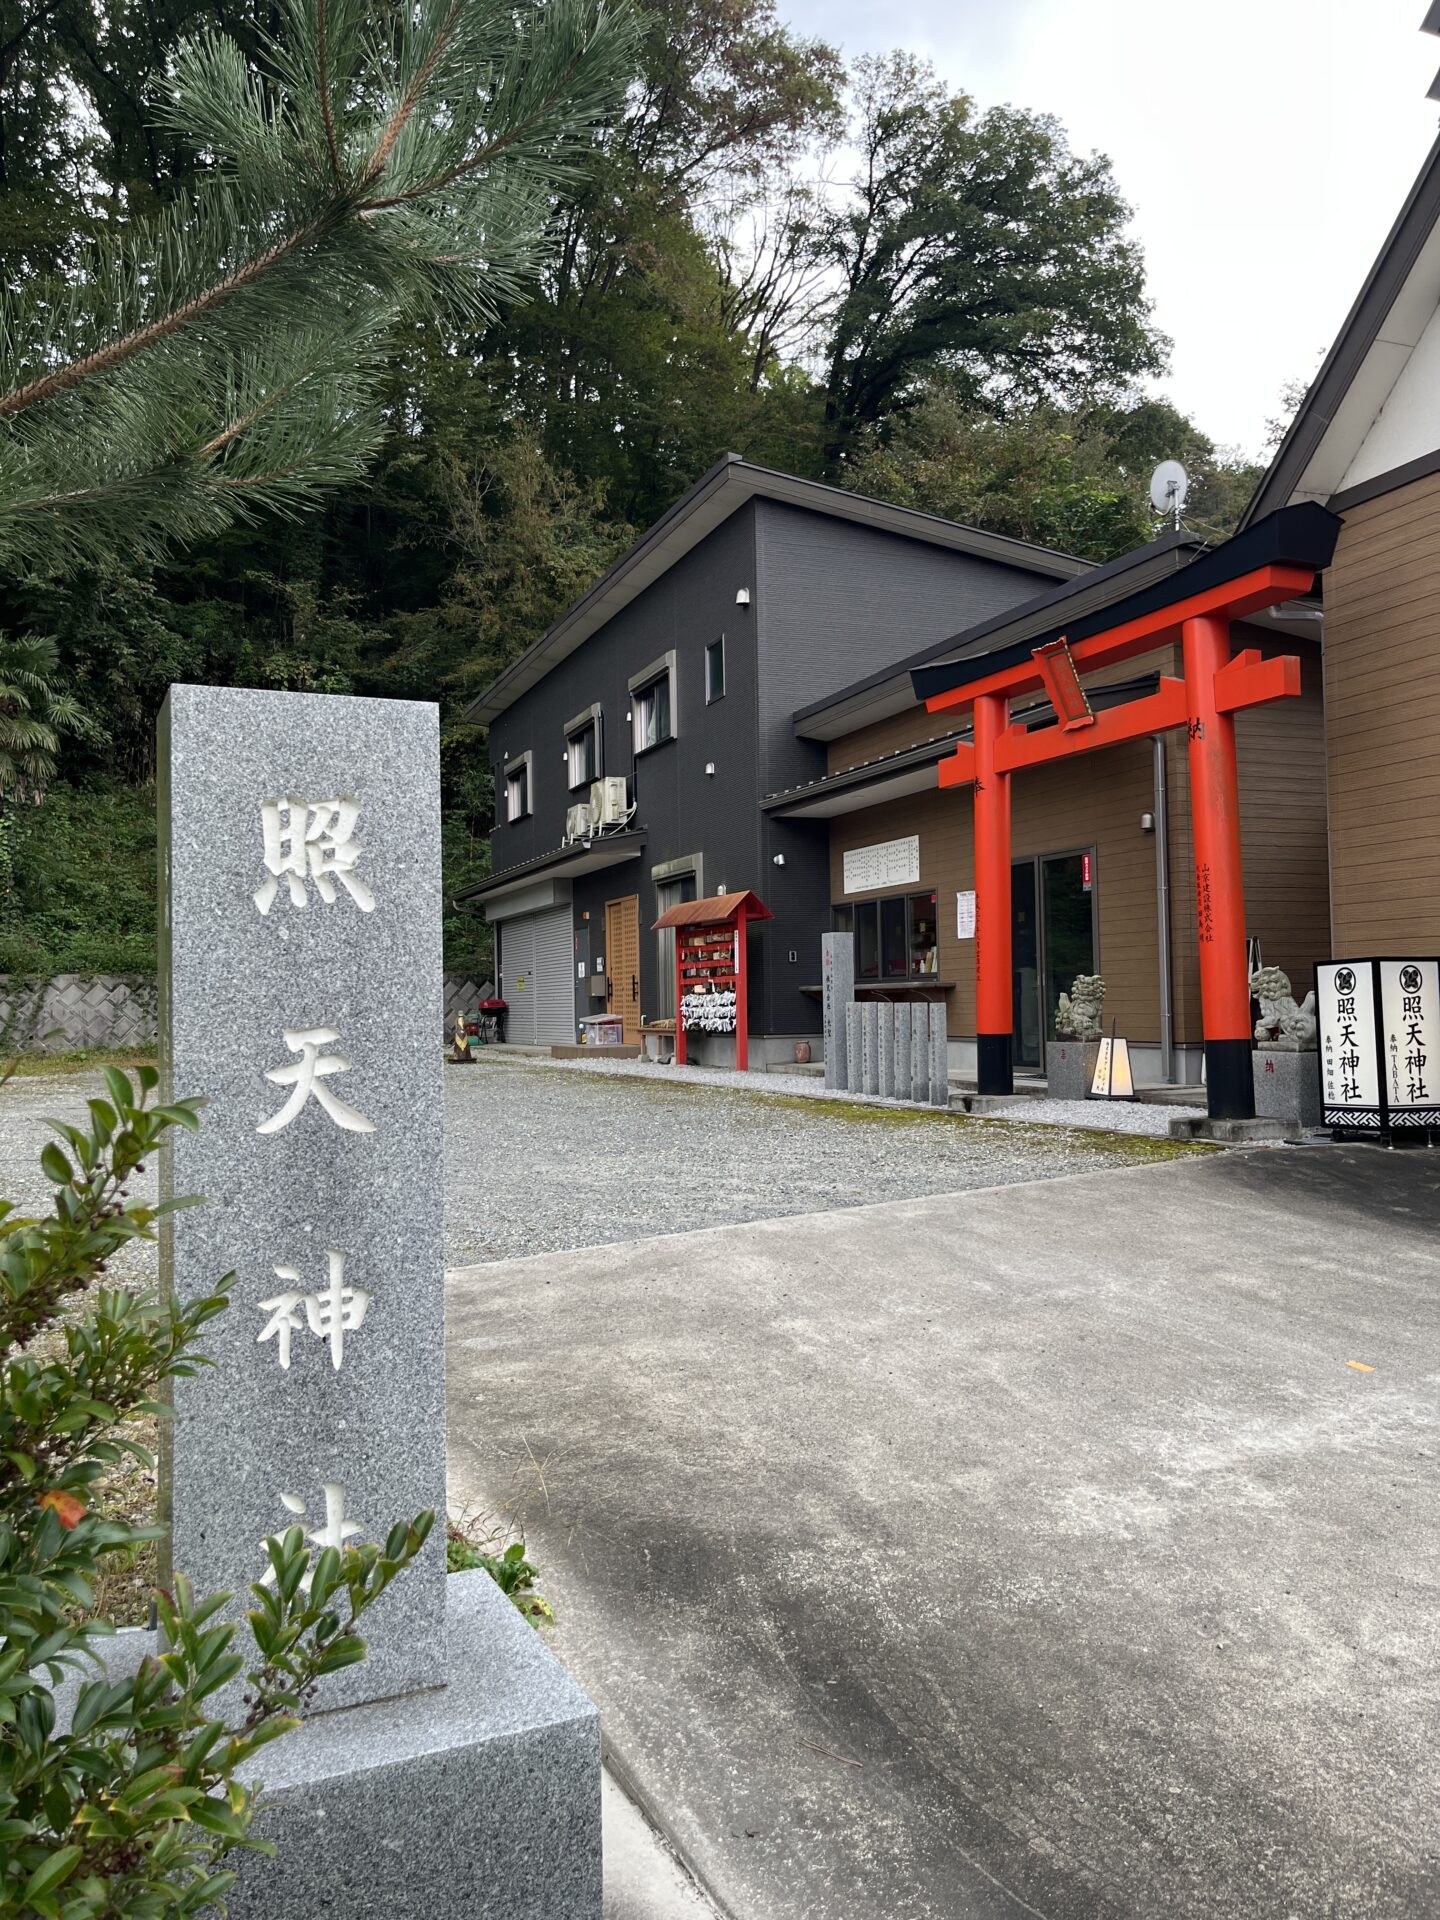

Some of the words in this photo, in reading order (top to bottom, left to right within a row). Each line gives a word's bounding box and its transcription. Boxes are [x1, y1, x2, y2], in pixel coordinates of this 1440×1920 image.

[1325, 1034, 1333, 1053] 奉納
[1337, 996, 1362, 1103] 照天神社
[1390, 1033, 1398, 1053] 奉納
[1402, 995, 1429, 1103] 照天神社
[1390, 1054, 1401, 1103] TABATA
